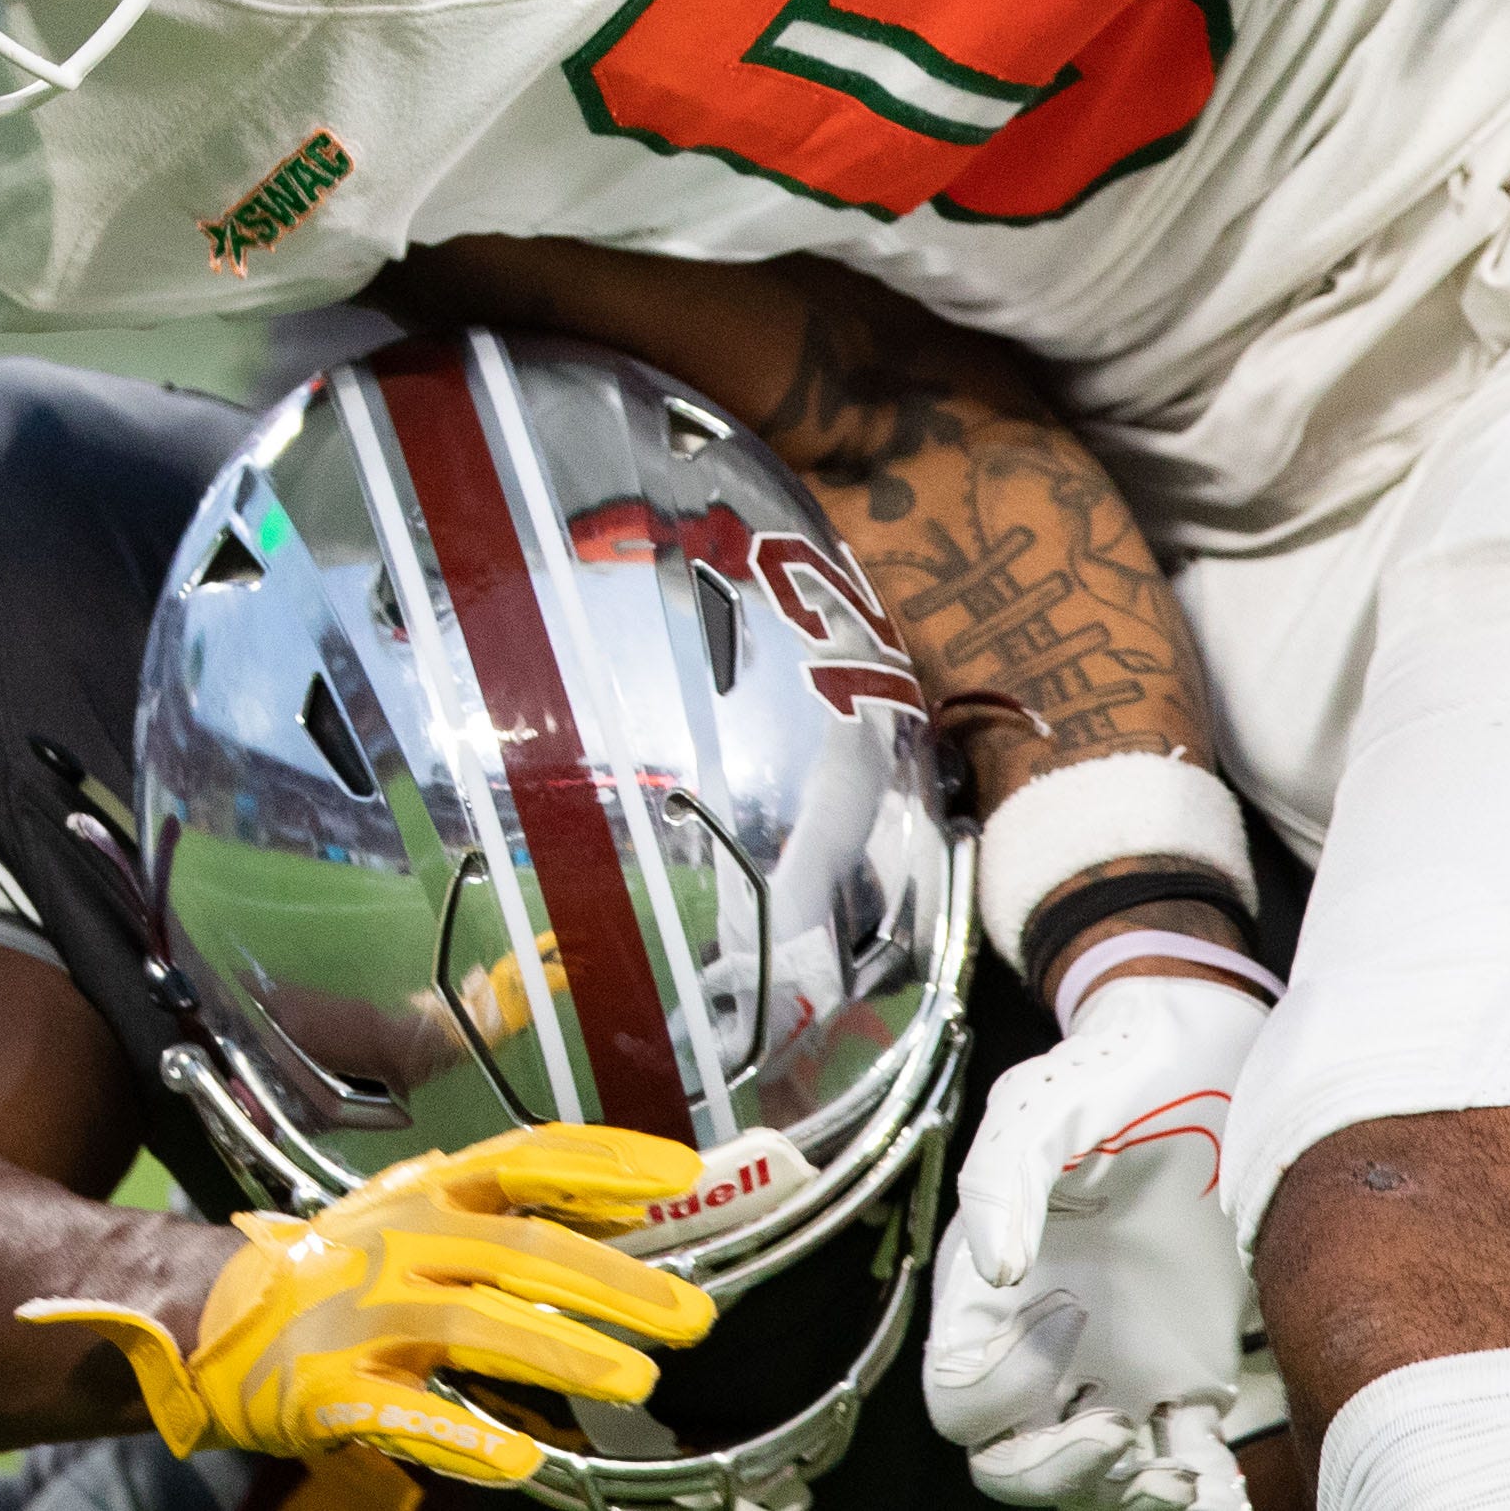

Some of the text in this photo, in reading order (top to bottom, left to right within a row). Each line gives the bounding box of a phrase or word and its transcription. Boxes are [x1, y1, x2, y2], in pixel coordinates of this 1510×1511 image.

[229, 130, 353, 246] SWAC
[746, 530, 931, 725] 12
[377, 1404, 507, 1456] BOOST
